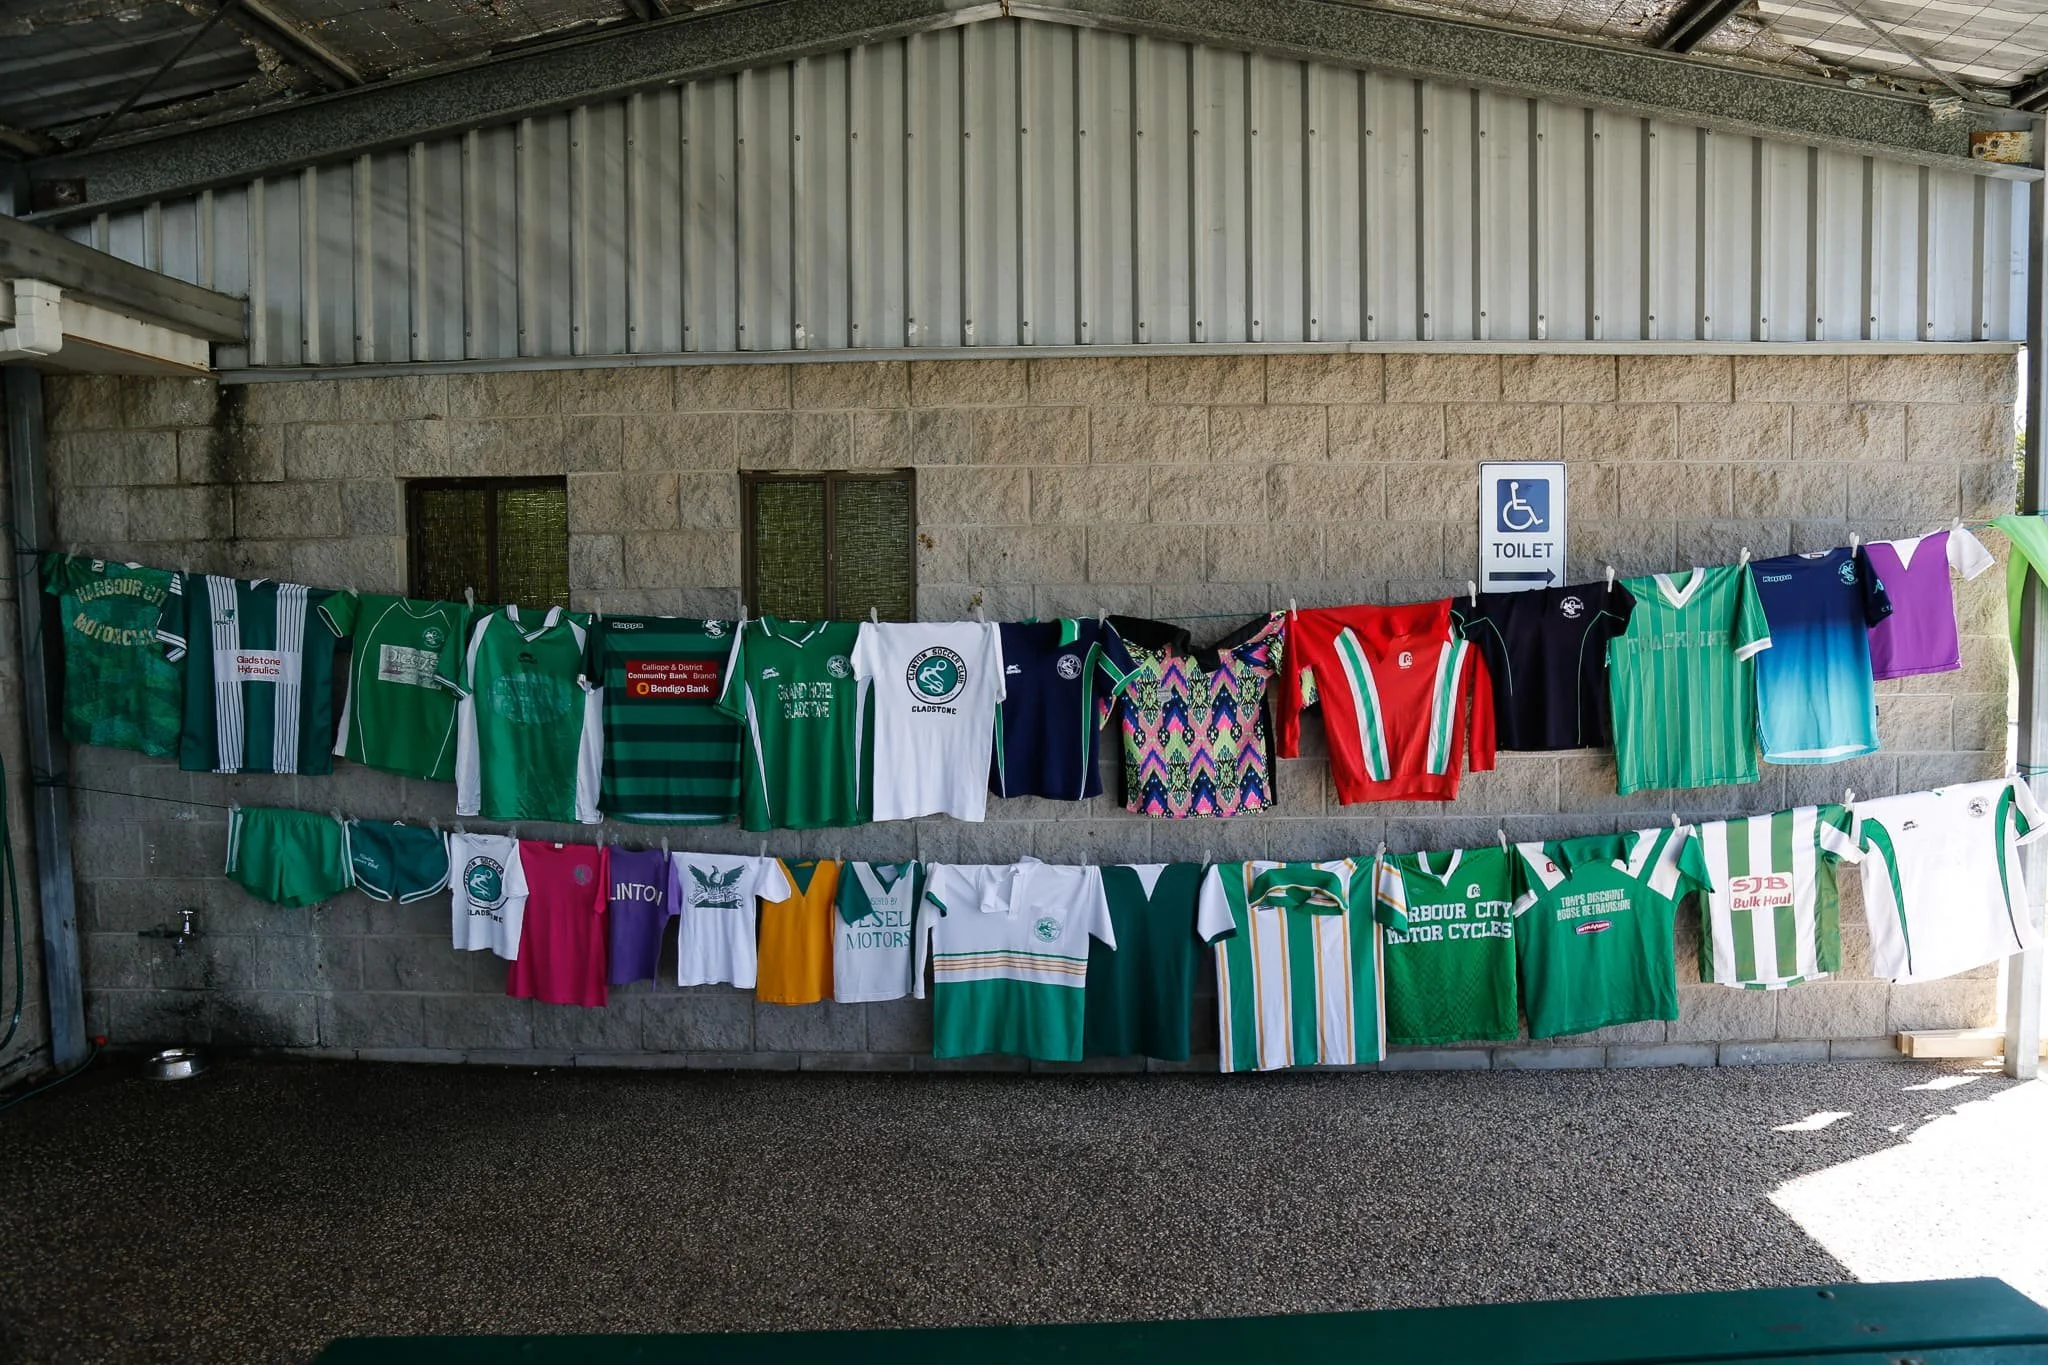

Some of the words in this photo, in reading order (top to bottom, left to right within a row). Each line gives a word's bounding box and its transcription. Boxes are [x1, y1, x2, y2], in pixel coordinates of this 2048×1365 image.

[1492, 542, 1554, 559] TOILET
[75, 579, 143, 604] HARBOUR
[143, 585, 168, 607] CIT
[612, 621, 644, 630] Kappa
[236, 655, 281, 666] Gladstone
[641, 663, 670, 672] Calliope
[678, 663, 704, 671] District
[908, 652, 928, 681] CLINTON
[931, 648, 961, 665] SOCCER
[237, 665, 280, 676] Hydraulics
[627, 672, 667, 680] Community
[650, 684, 686, 695] Bendigo
[686, 684, 710, 693] Bank
[911, 705, 958, 715] GLADSTONE
[1732, 876, 1789, 894] SJB
[609, 883, 663, 907] INTO
[1560, 893, 1586, 908] TOM'S
[1587, 888, 1624, 904] DISCOUNT
[1733, 896, 1761, 909] Bulk
[1763, 892, 1792, 906] Haul
[1408, 903, 1467, 923] RBOUR
[1475, 900, 1513, 918] CITY
[1582, 899, 1631, 917] RETRAVISION
[846, 931, 911, 950] MOTORS
[1386, 925, 1444, 945] MOTOR
[1448, 920, 1512, 940] CYCLES
